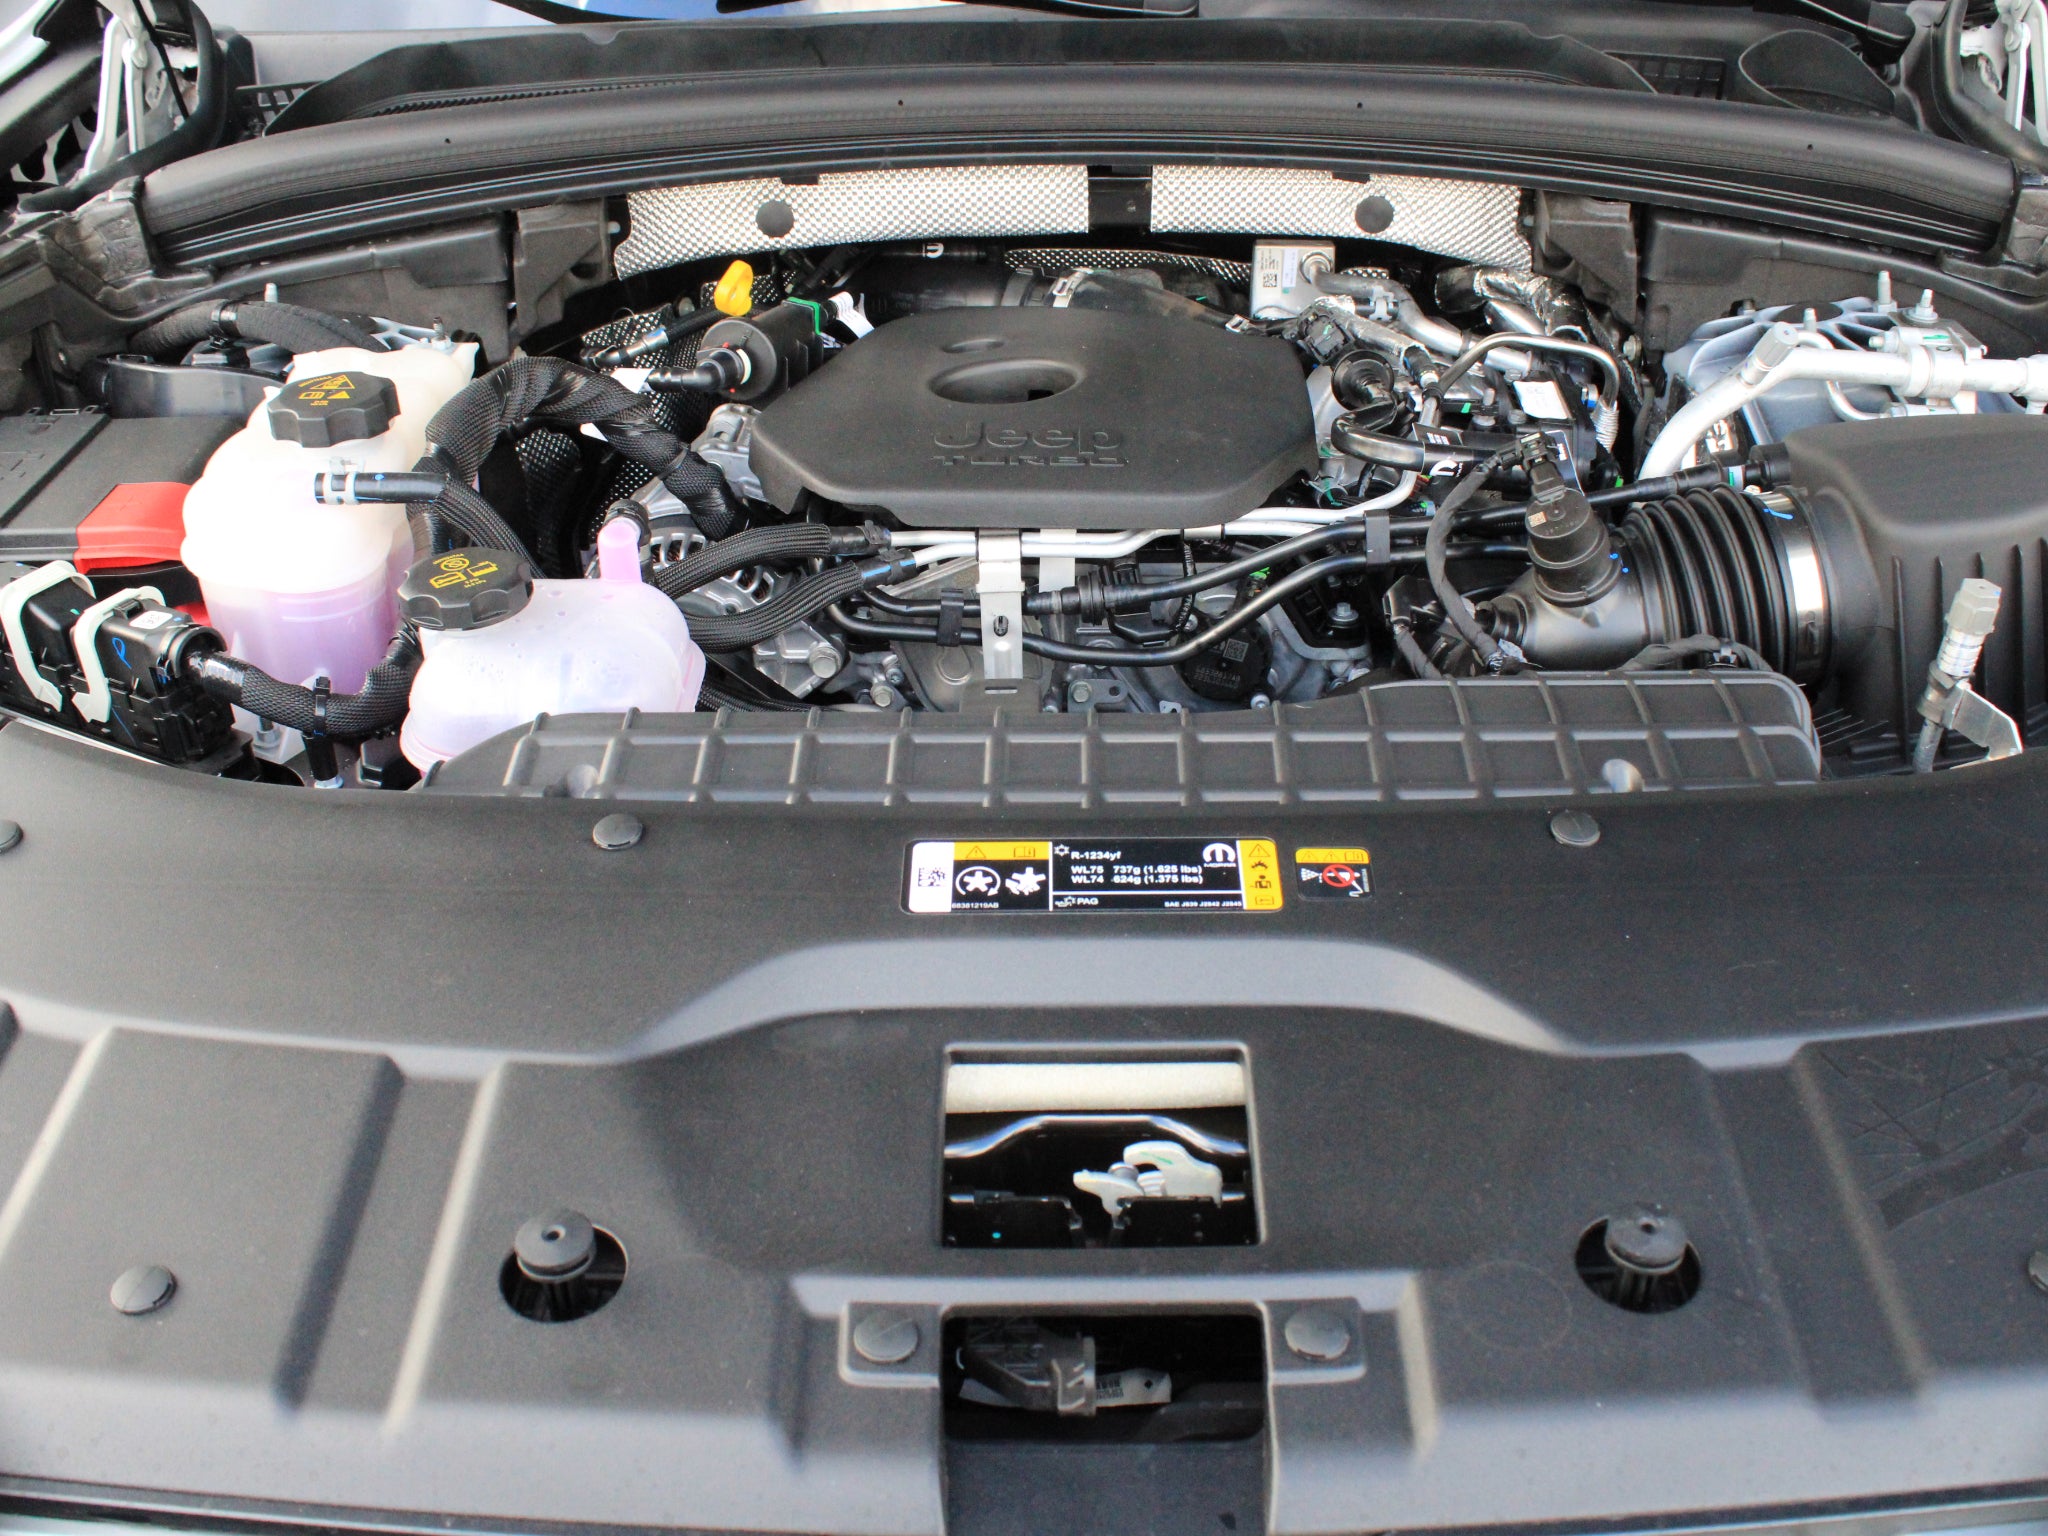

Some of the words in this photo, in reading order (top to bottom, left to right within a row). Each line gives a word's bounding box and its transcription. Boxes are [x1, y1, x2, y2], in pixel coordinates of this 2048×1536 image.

[933, 422, 1123, 455] Jeep
[1070, 851, 1121, 861] R-1234yf
[1071, 865, 1104, 874] WL75
[1113, 865, 1141, 875] 737g
[1143, 864, 1178, 875] (1.625
[1180, 864, 1203, 875] lbs)
[1071, 875, 1104, 883] WL74
[1112, 875, 1141, 885] 624g
[1143, 874, 1179, 885] (1.375
[1181, 874, 1203, 885] lbs)
[1077, 897, 1099, 906] PAG
